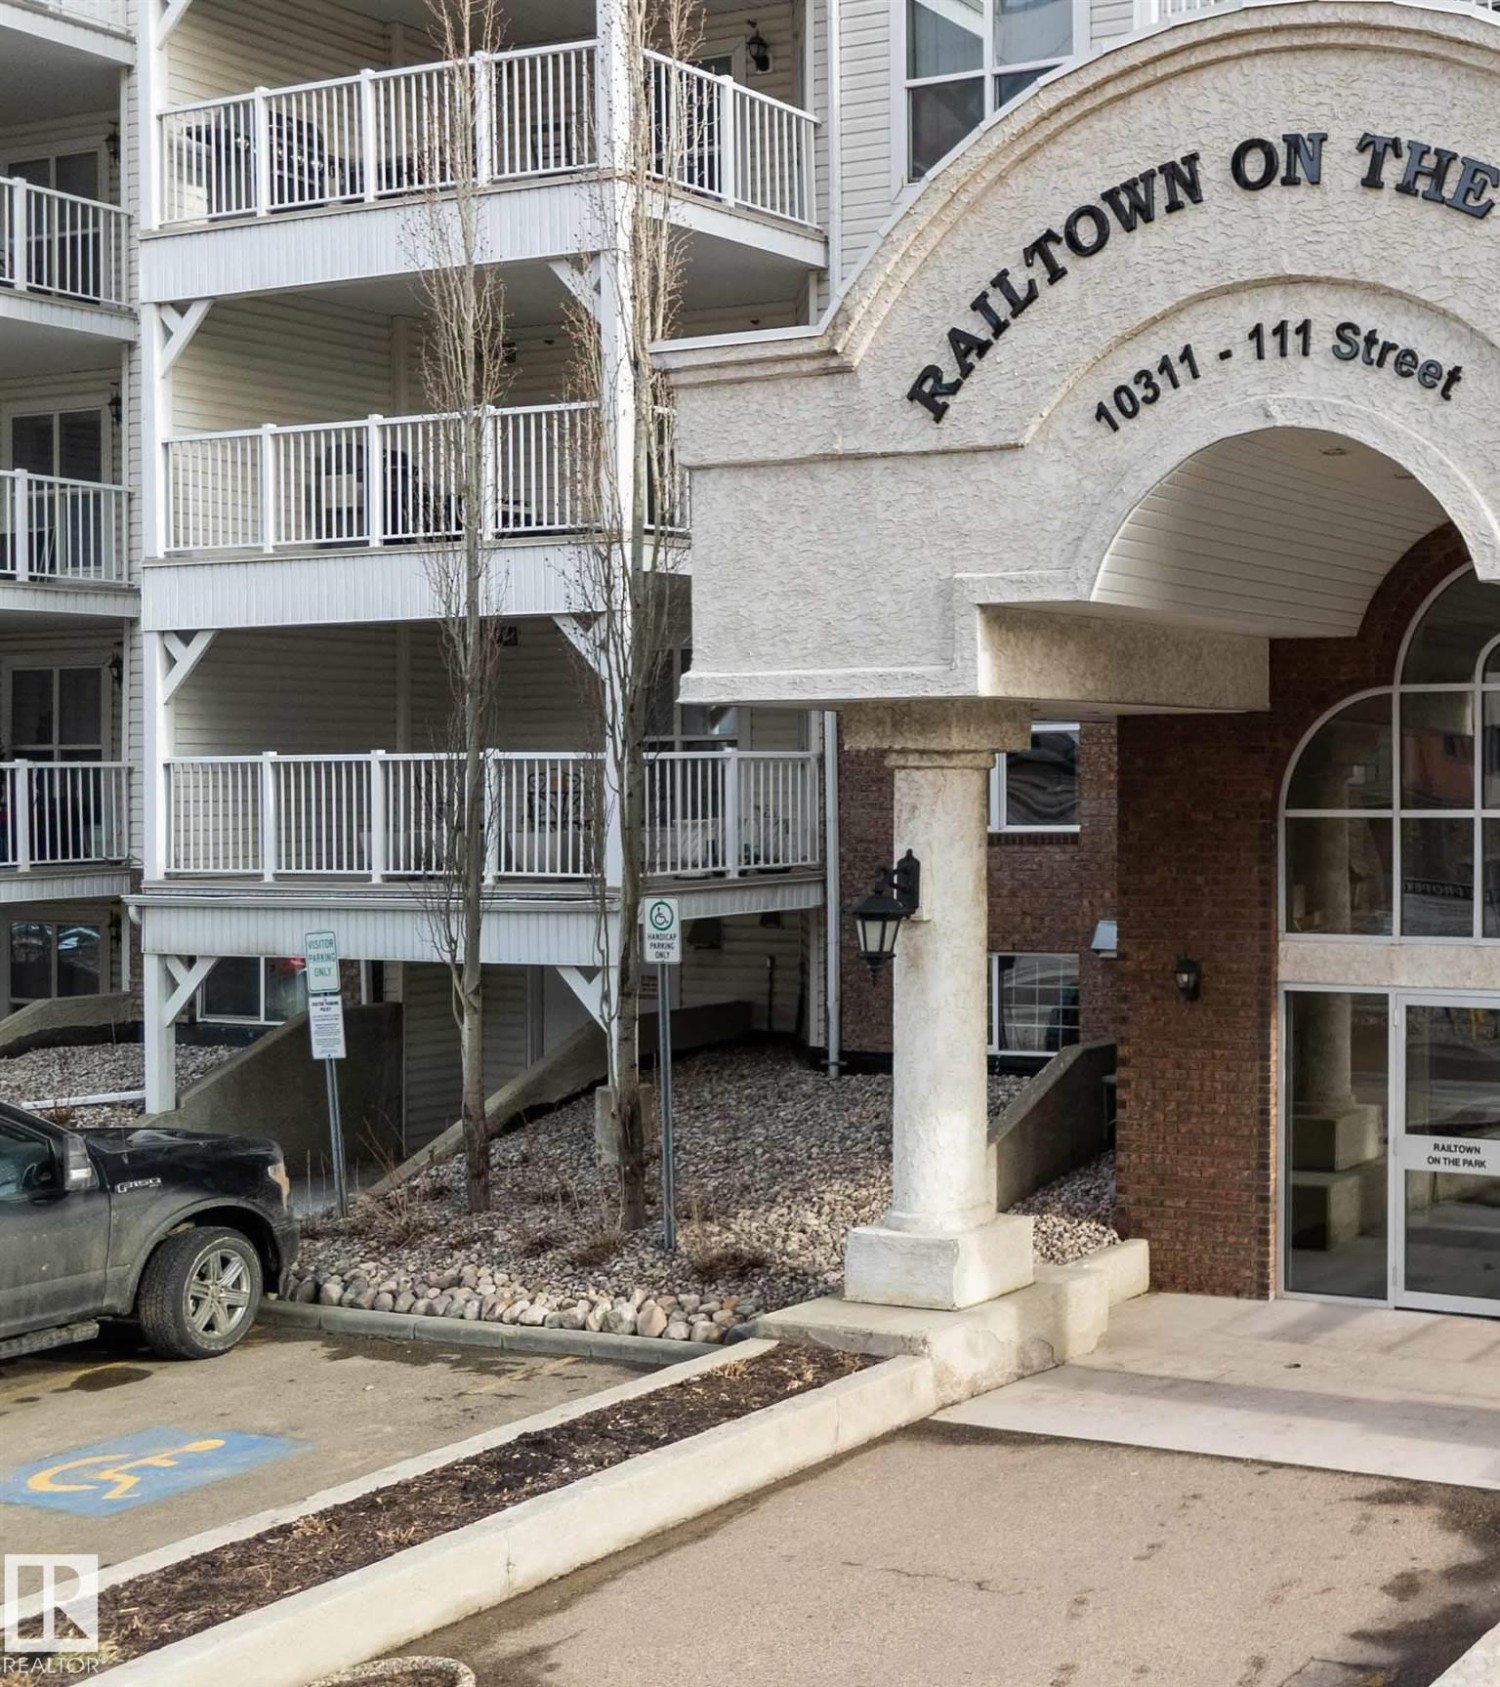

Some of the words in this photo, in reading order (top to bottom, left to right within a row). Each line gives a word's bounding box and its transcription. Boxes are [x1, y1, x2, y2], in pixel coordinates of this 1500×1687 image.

[907, 152, 1203, 424] RAILTOWN
[1231, 132, 1328, 191] ON
[1355, 132, 1500, 219] THE
[1094, 343, 1201, 432] 10311
[1247, 318, 1312, 361] 111
[1331, 321, 1464, 401] Street
[648, 933, 677, 941] HANDICAP
[308, 939, 334, 949] VISITOR
[650, 942, 675, 950] PARKING
[308, 952, 336, 962] PARKING
[655, 951, 670, 959] ONLY
[314, 967, 331, 976] ONLY
[1433, 1143, 1481, 1154] RAILTOWN
[1427, 1156, 1440, 1165] ON
[1443, 1157, 1460, 1167] THE
[1462, 1158, 1487, 1169] PARK
